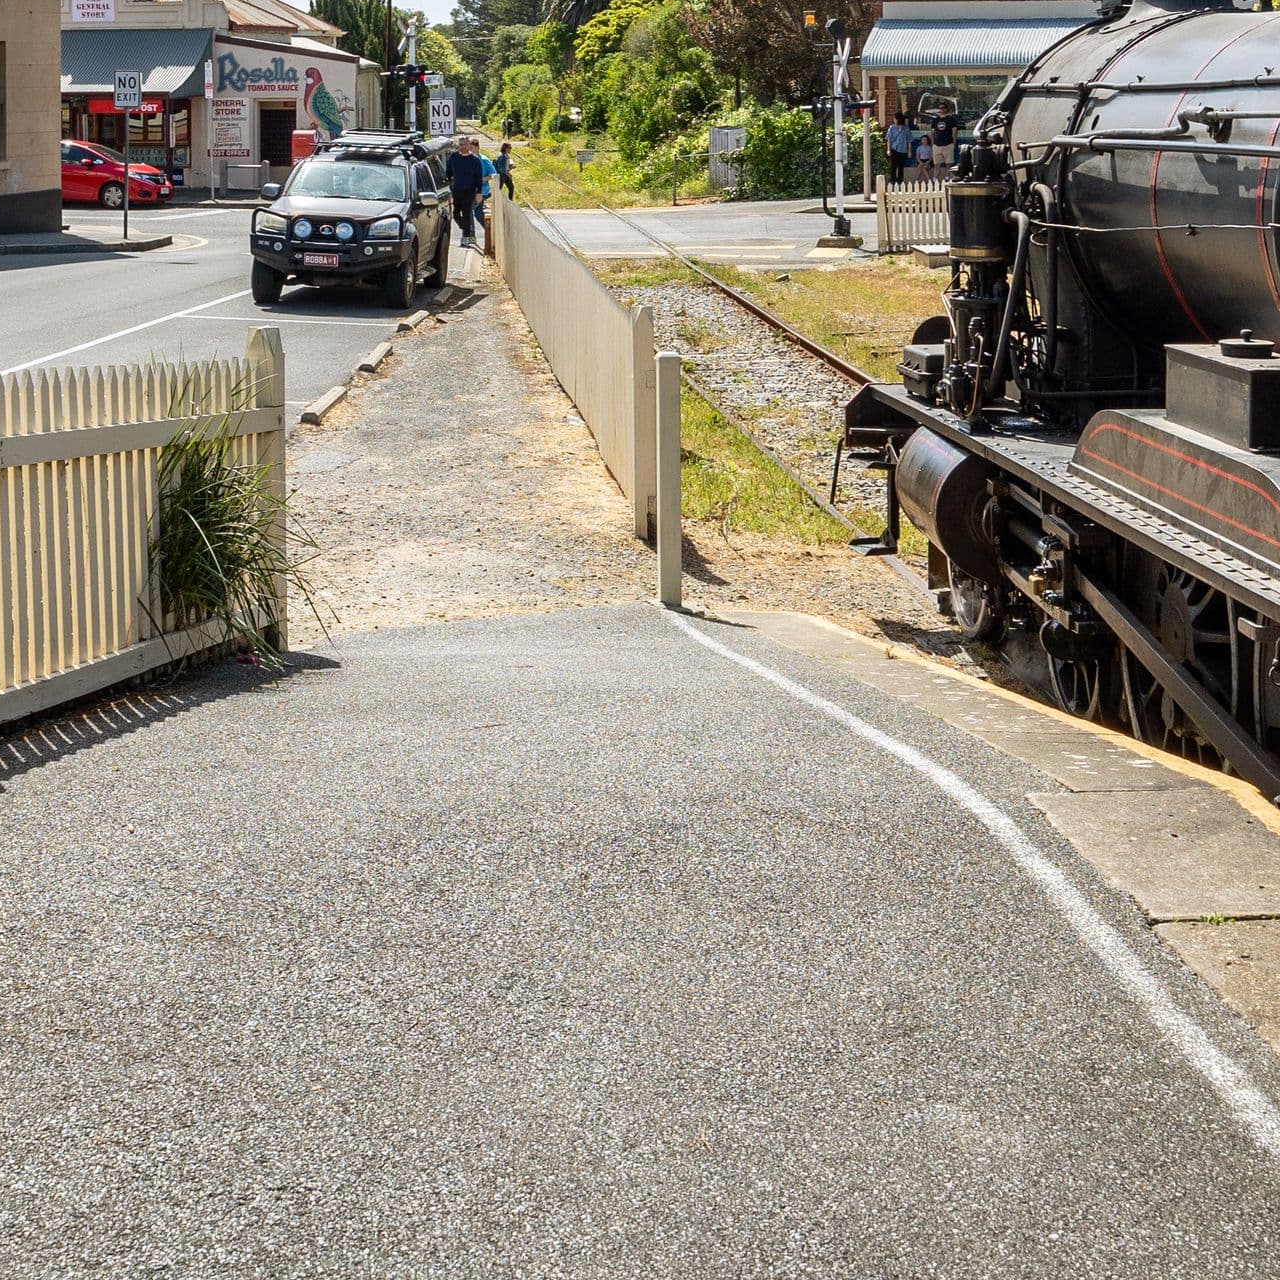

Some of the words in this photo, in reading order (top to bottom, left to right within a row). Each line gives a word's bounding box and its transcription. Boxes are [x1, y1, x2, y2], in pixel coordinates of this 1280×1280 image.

[217, 51, 299, 93] Rosella
[118, 77, 137, 89] NO
[117, 93, 137, 101] EXIT
[432, 104, 450, 117] NO
[432, 121, 451, 130] EXIT
